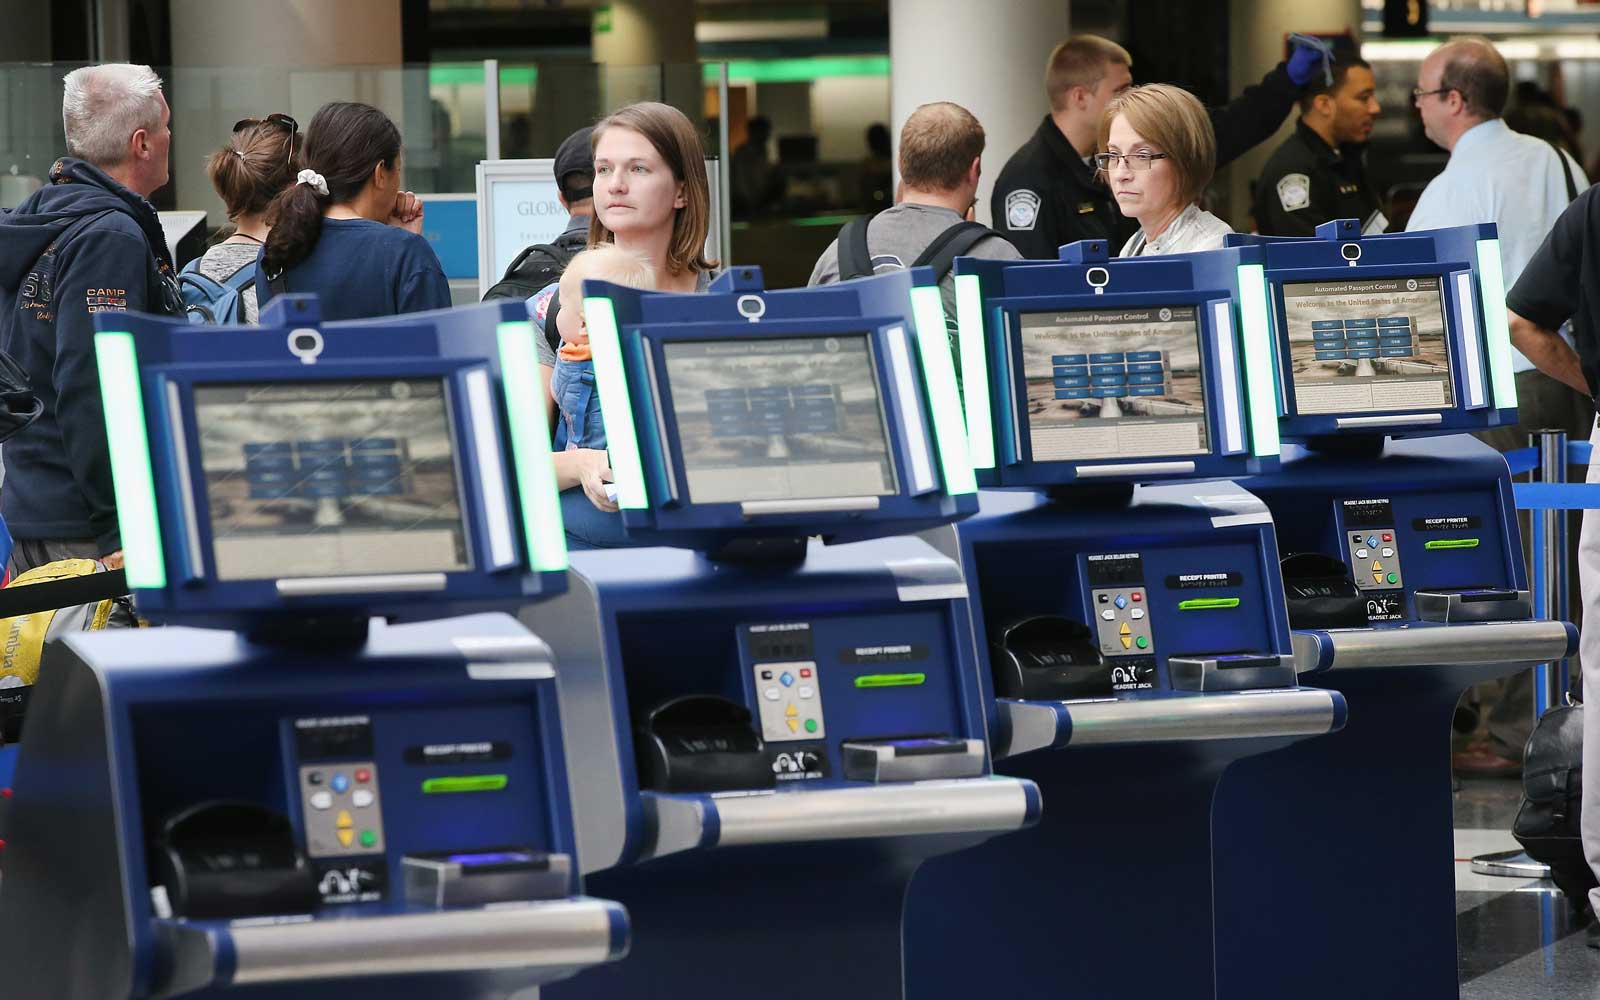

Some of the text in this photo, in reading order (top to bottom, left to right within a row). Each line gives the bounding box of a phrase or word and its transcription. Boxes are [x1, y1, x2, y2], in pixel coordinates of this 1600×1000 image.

[87, 288, 126, 296] CAMP
[1314, 283, 1397, 293] Automated Passport Control
[1055, 312, 1149, 323] Automated Passport Control
[1203, 573, 1228, 581] PRINTER
